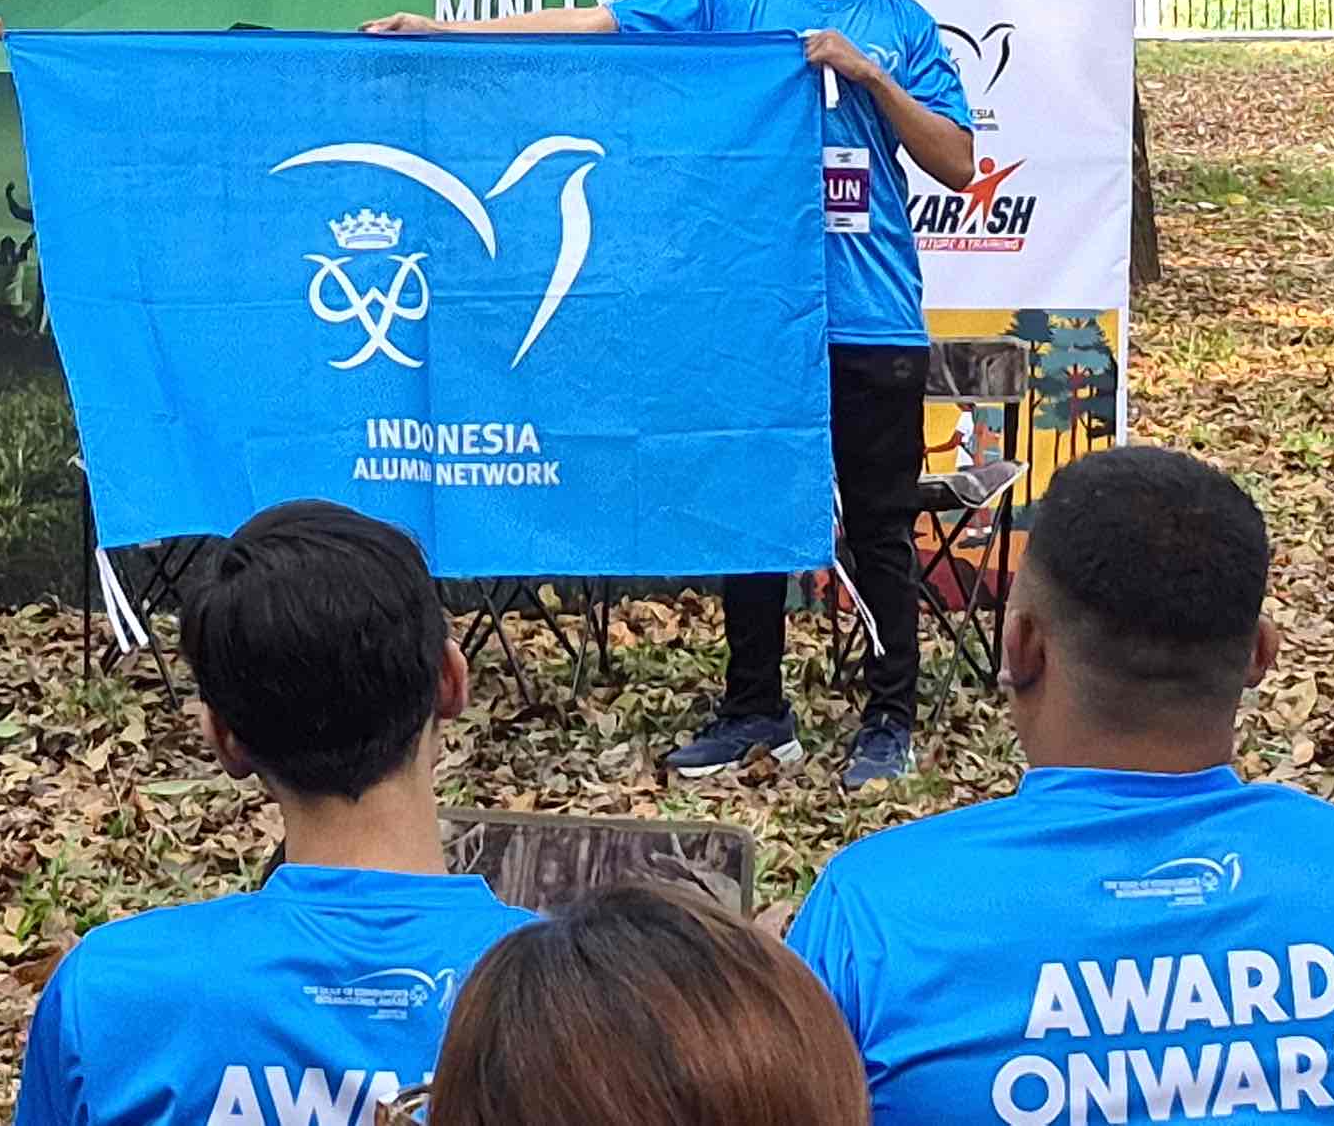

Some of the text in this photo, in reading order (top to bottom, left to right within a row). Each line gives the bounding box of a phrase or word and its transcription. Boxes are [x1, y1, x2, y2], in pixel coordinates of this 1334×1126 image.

[828, 177, 861, 201] UN
[366, 417, 542, 455] INDONESIA
[352, 456, 561, 487] ALUMNI NETWORK
